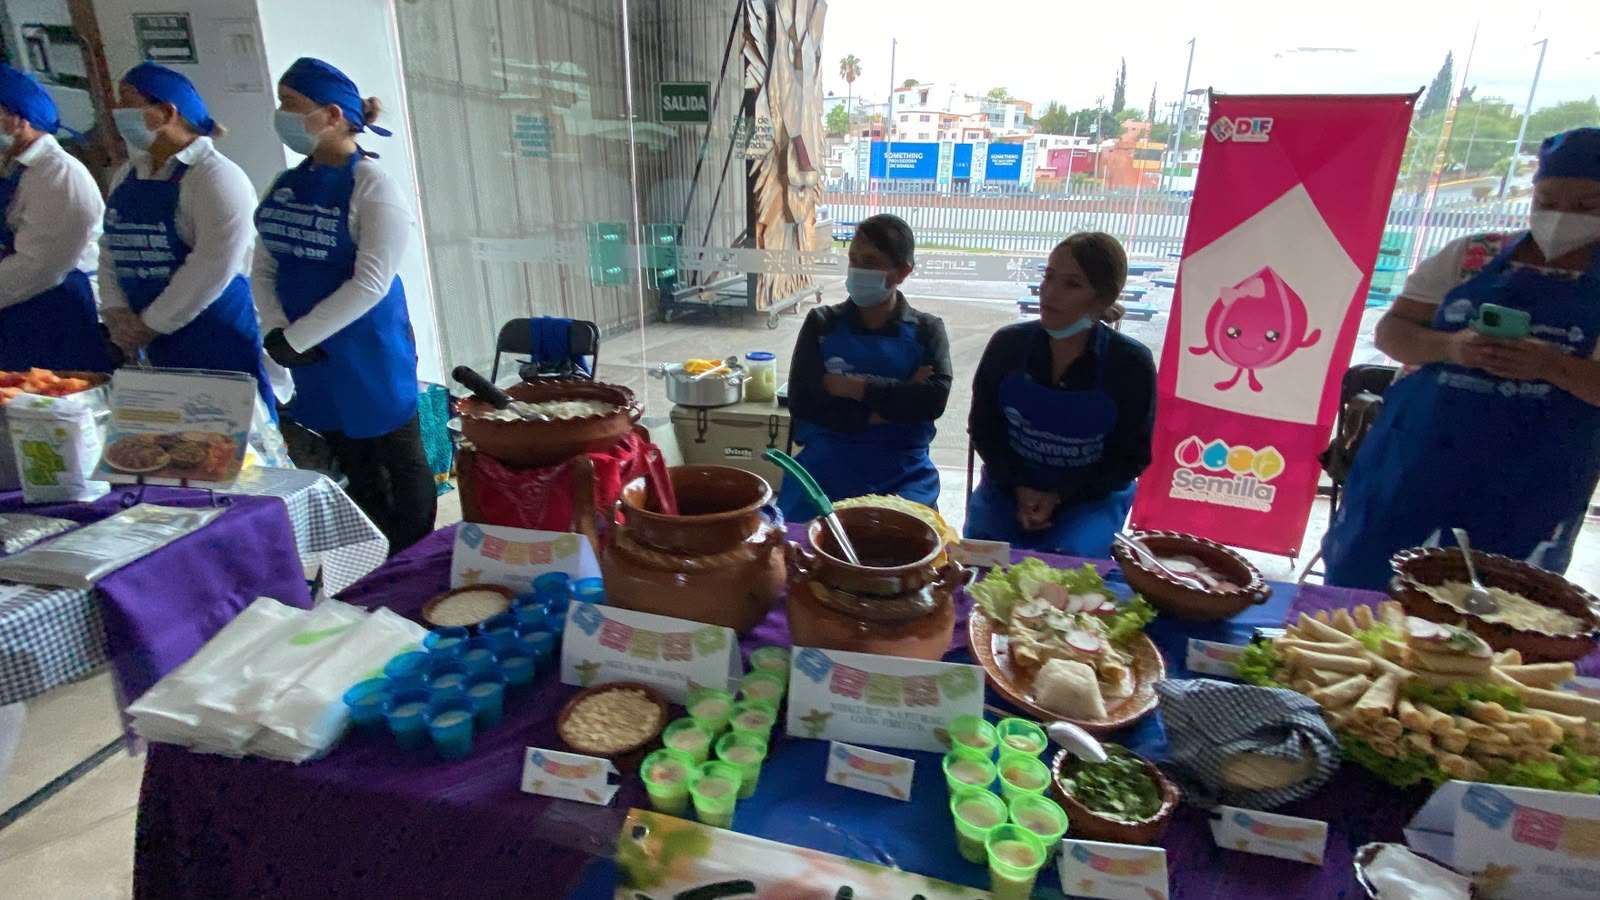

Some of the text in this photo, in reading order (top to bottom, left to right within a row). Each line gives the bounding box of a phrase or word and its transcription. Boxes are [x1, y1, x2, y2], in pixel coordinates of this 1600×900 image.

[663, 95, 707, 111] SALIDA
[1236, 118, 1272, 135] DIF
[1174, 469, 1275, 501] Semilla
